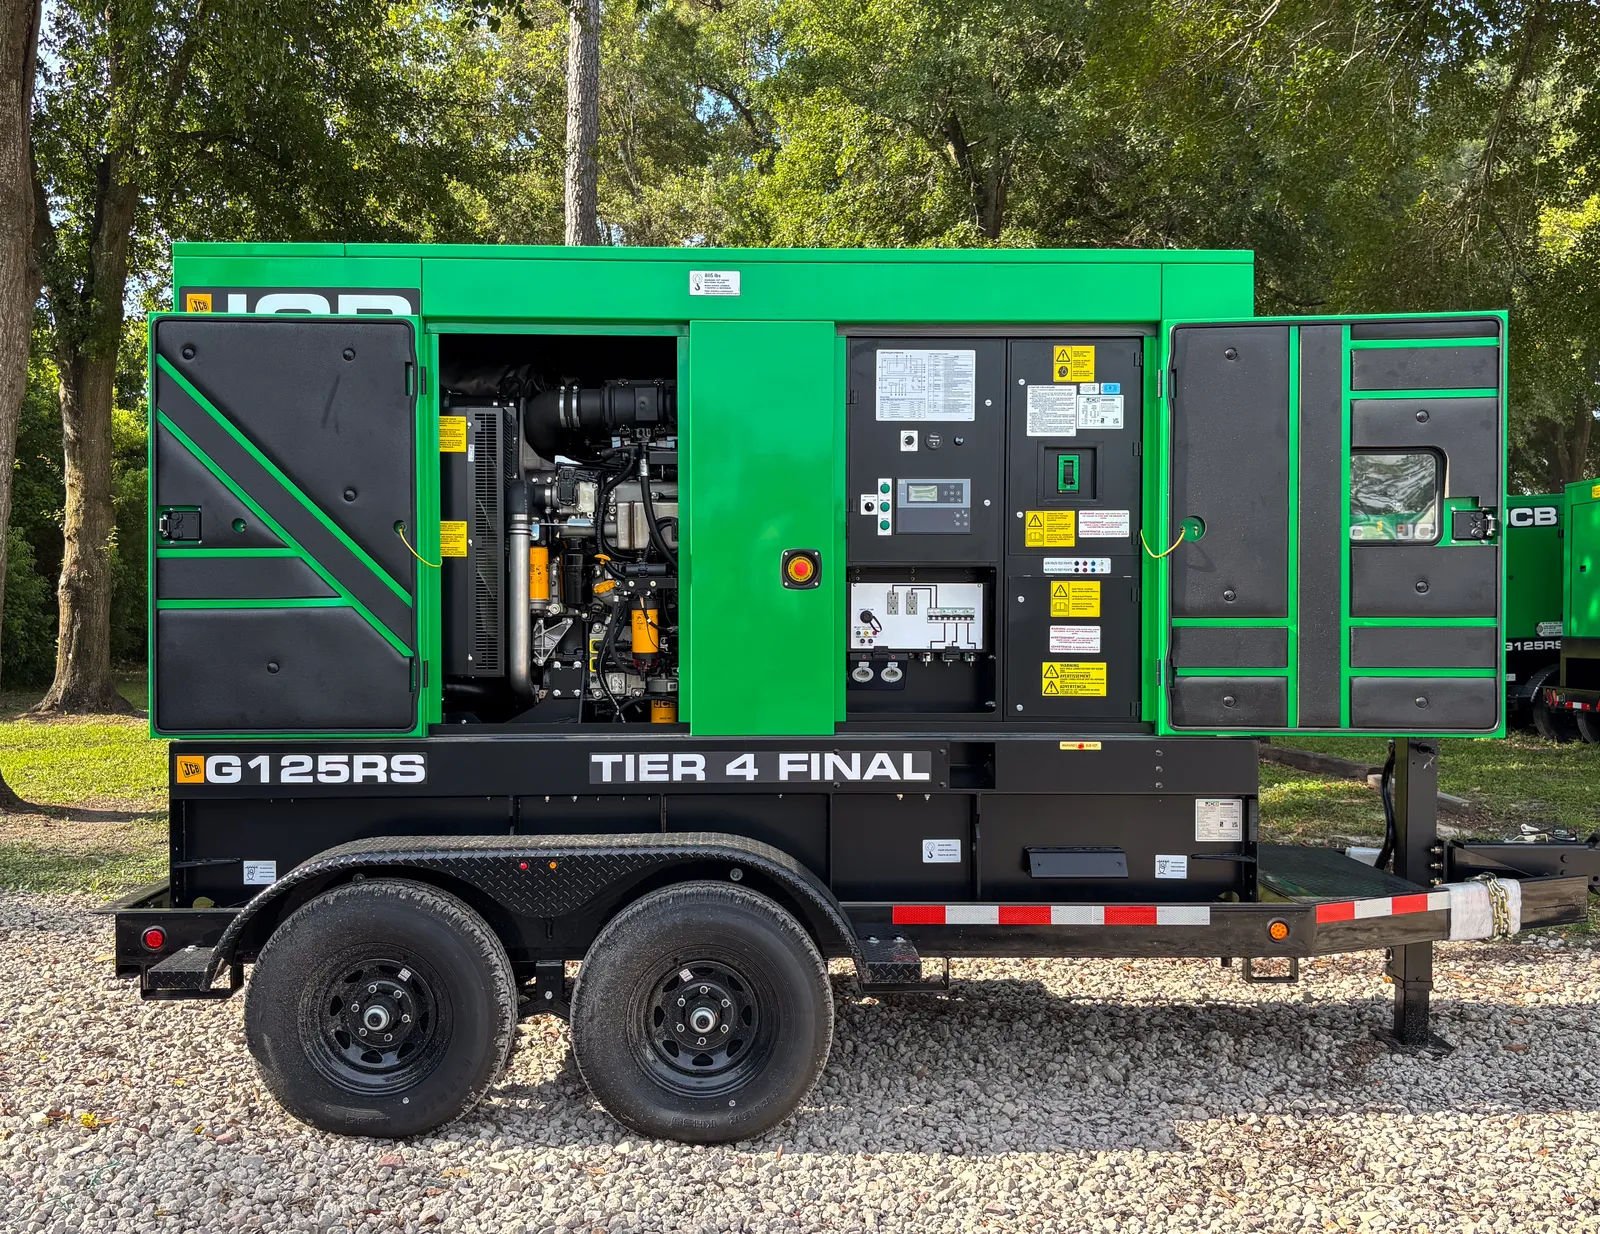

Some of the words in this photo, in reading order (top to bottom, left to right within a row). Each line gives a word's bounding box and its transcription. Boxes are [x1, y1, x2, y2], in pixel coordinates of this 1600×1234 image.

[193, 300, 208, 312] JCB
[1506, 506, 1558, 527] CB
[183, 761, 200, 777] JCB
[205, 755, 426, 783] G125RS
[591, 754, 706, 782] TIER
[725, 753, 759, 781] 4
[778, 753, 930, 781] FINAL
